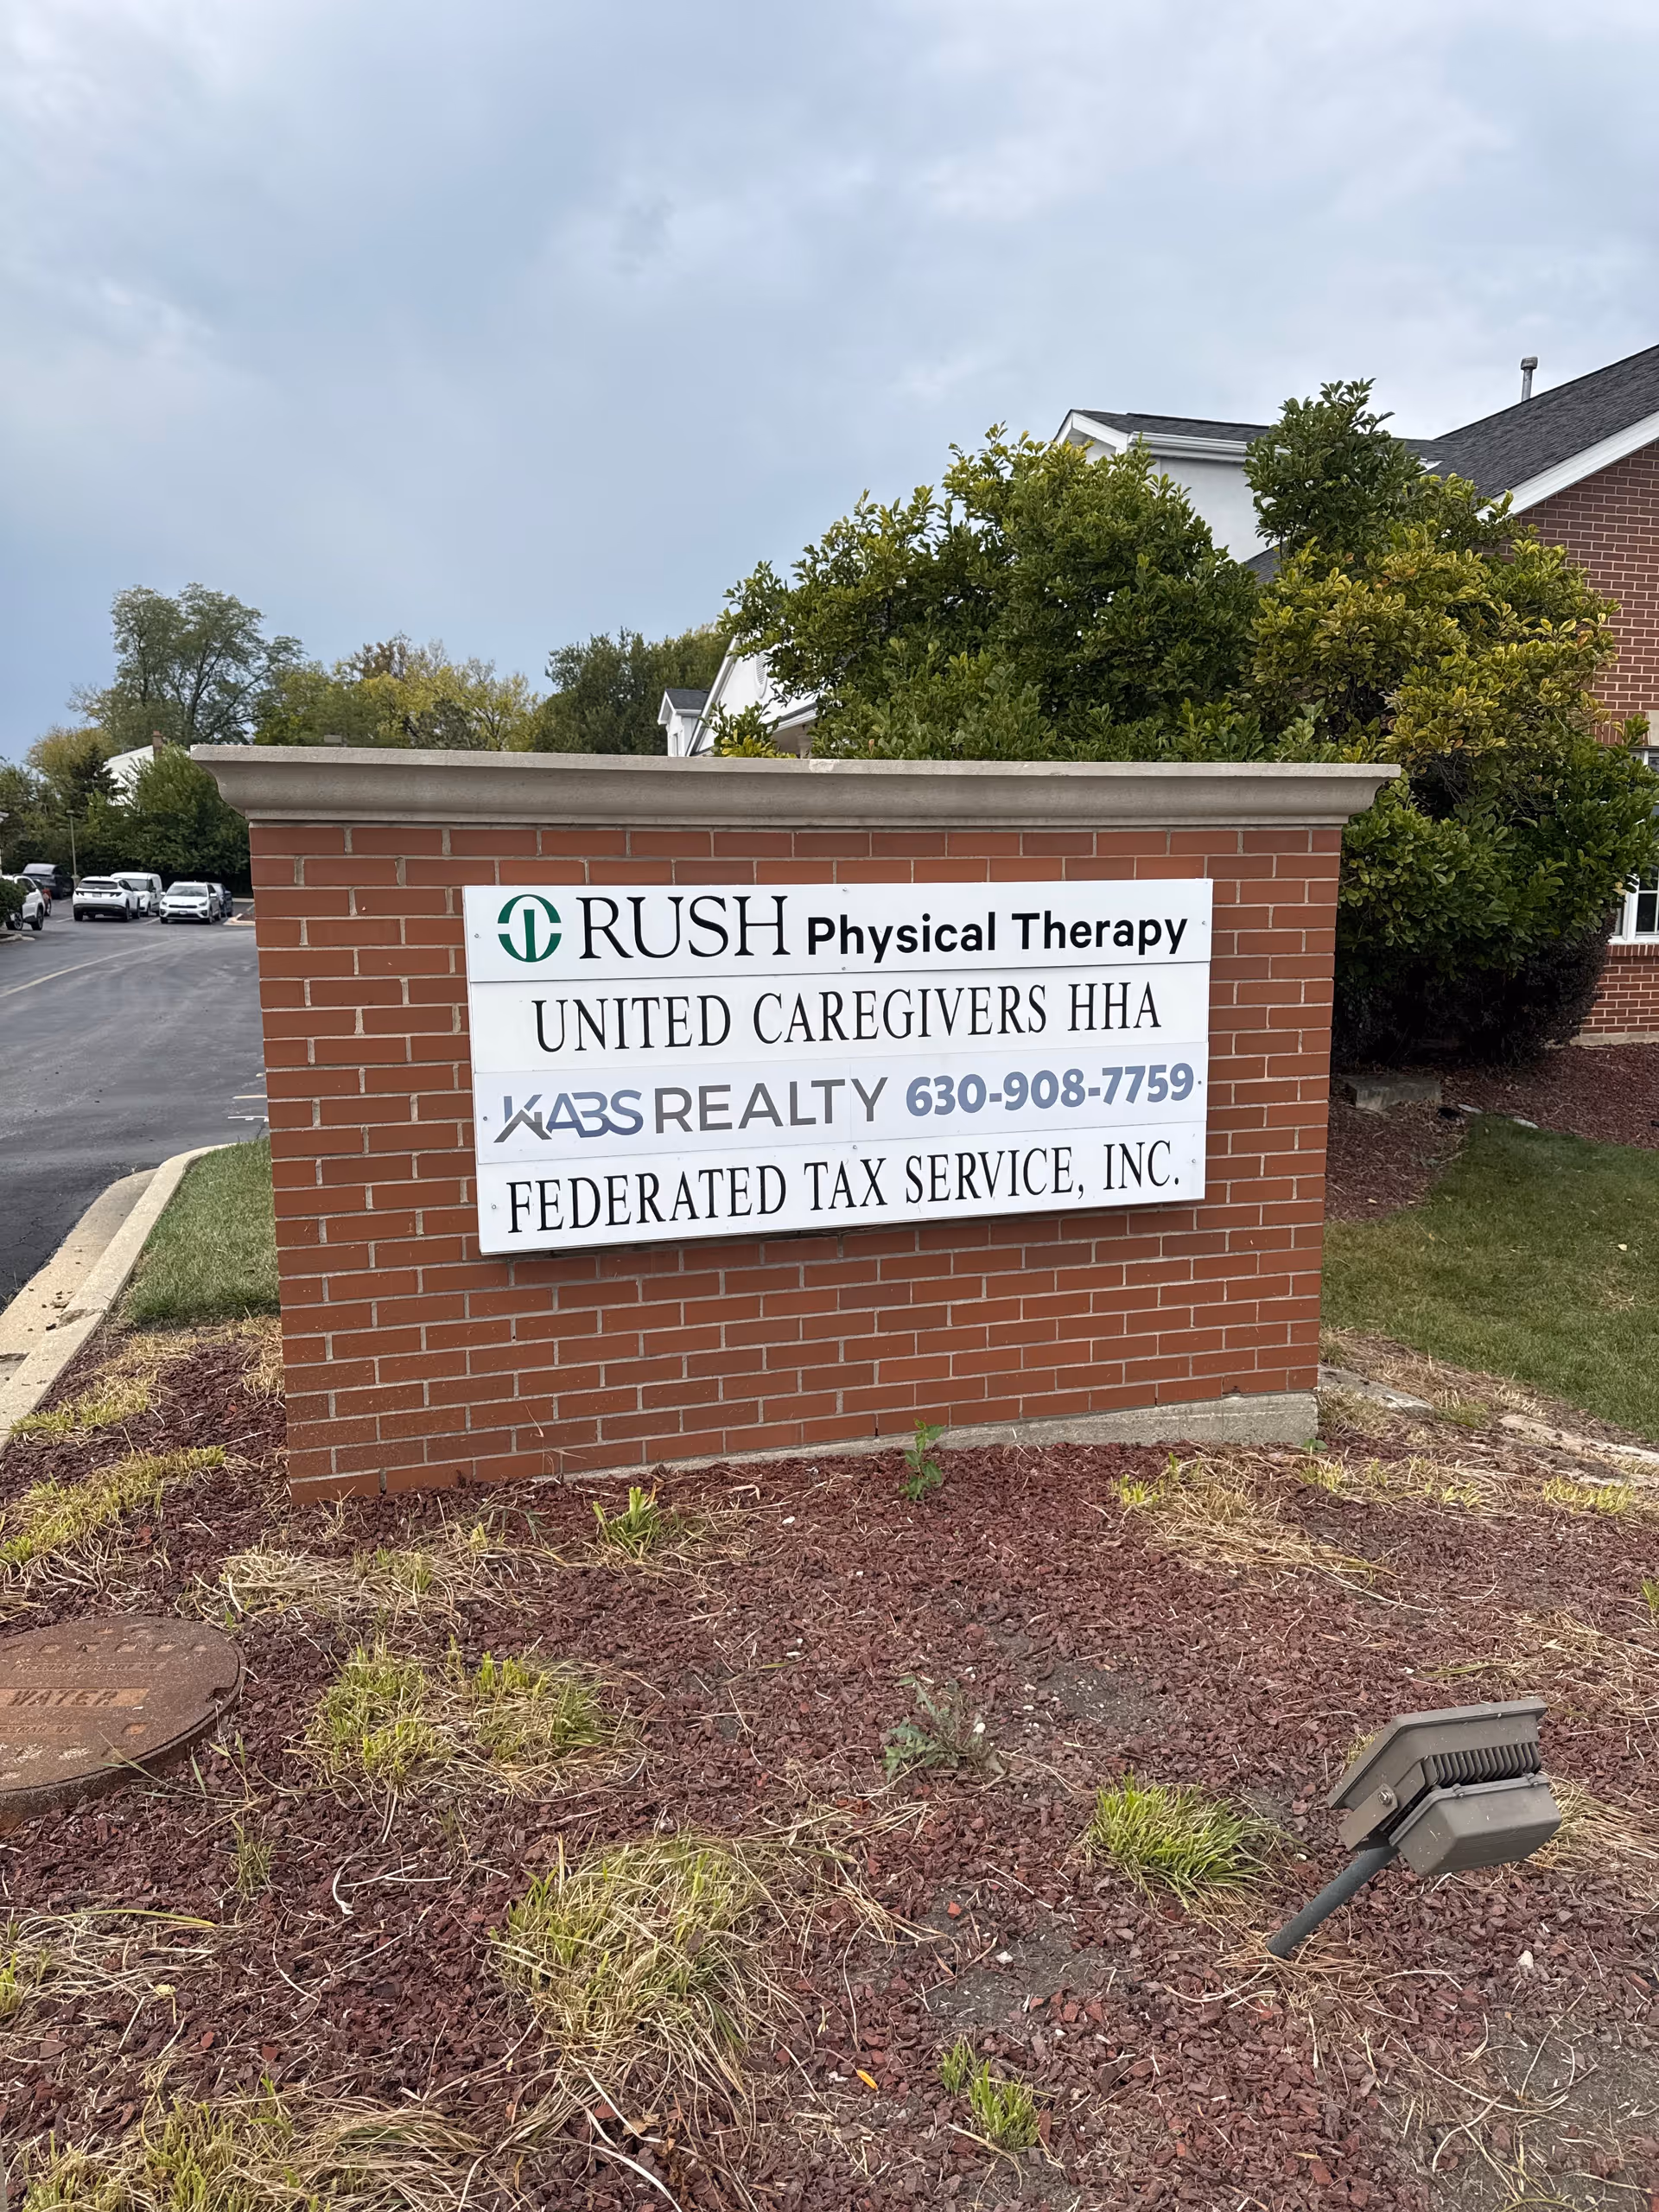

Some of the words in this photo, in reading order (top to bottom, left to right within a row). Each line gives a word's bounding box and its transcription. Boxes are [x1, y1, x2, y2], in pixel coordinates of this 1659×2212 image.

[576, 896, 791, 959] RUSH
[807, 912, 996, 963] Physical
[1011, 911, 1188, 956] Therapy
[531, 995, 731, 1052] UNITED
[753, 985, 1046, 1044] CAREGIVERS
[1068, 982, 1162, 1031] HHA
[493, 1090, 644, 1144] KABS
[654, 1077, 888, 1135] REALTY
[906, 1063, 1194, 1117] 630-908-7759
[506, 1166, 786, 1234] FEDERATED
[804, 1158, 888, 1211] TAX
[906, 1147, 1084, 1204] SERVICE,
[1103, 1140, 1179, 1191] INC.
[7, 1689, 118, 1707] WATER
